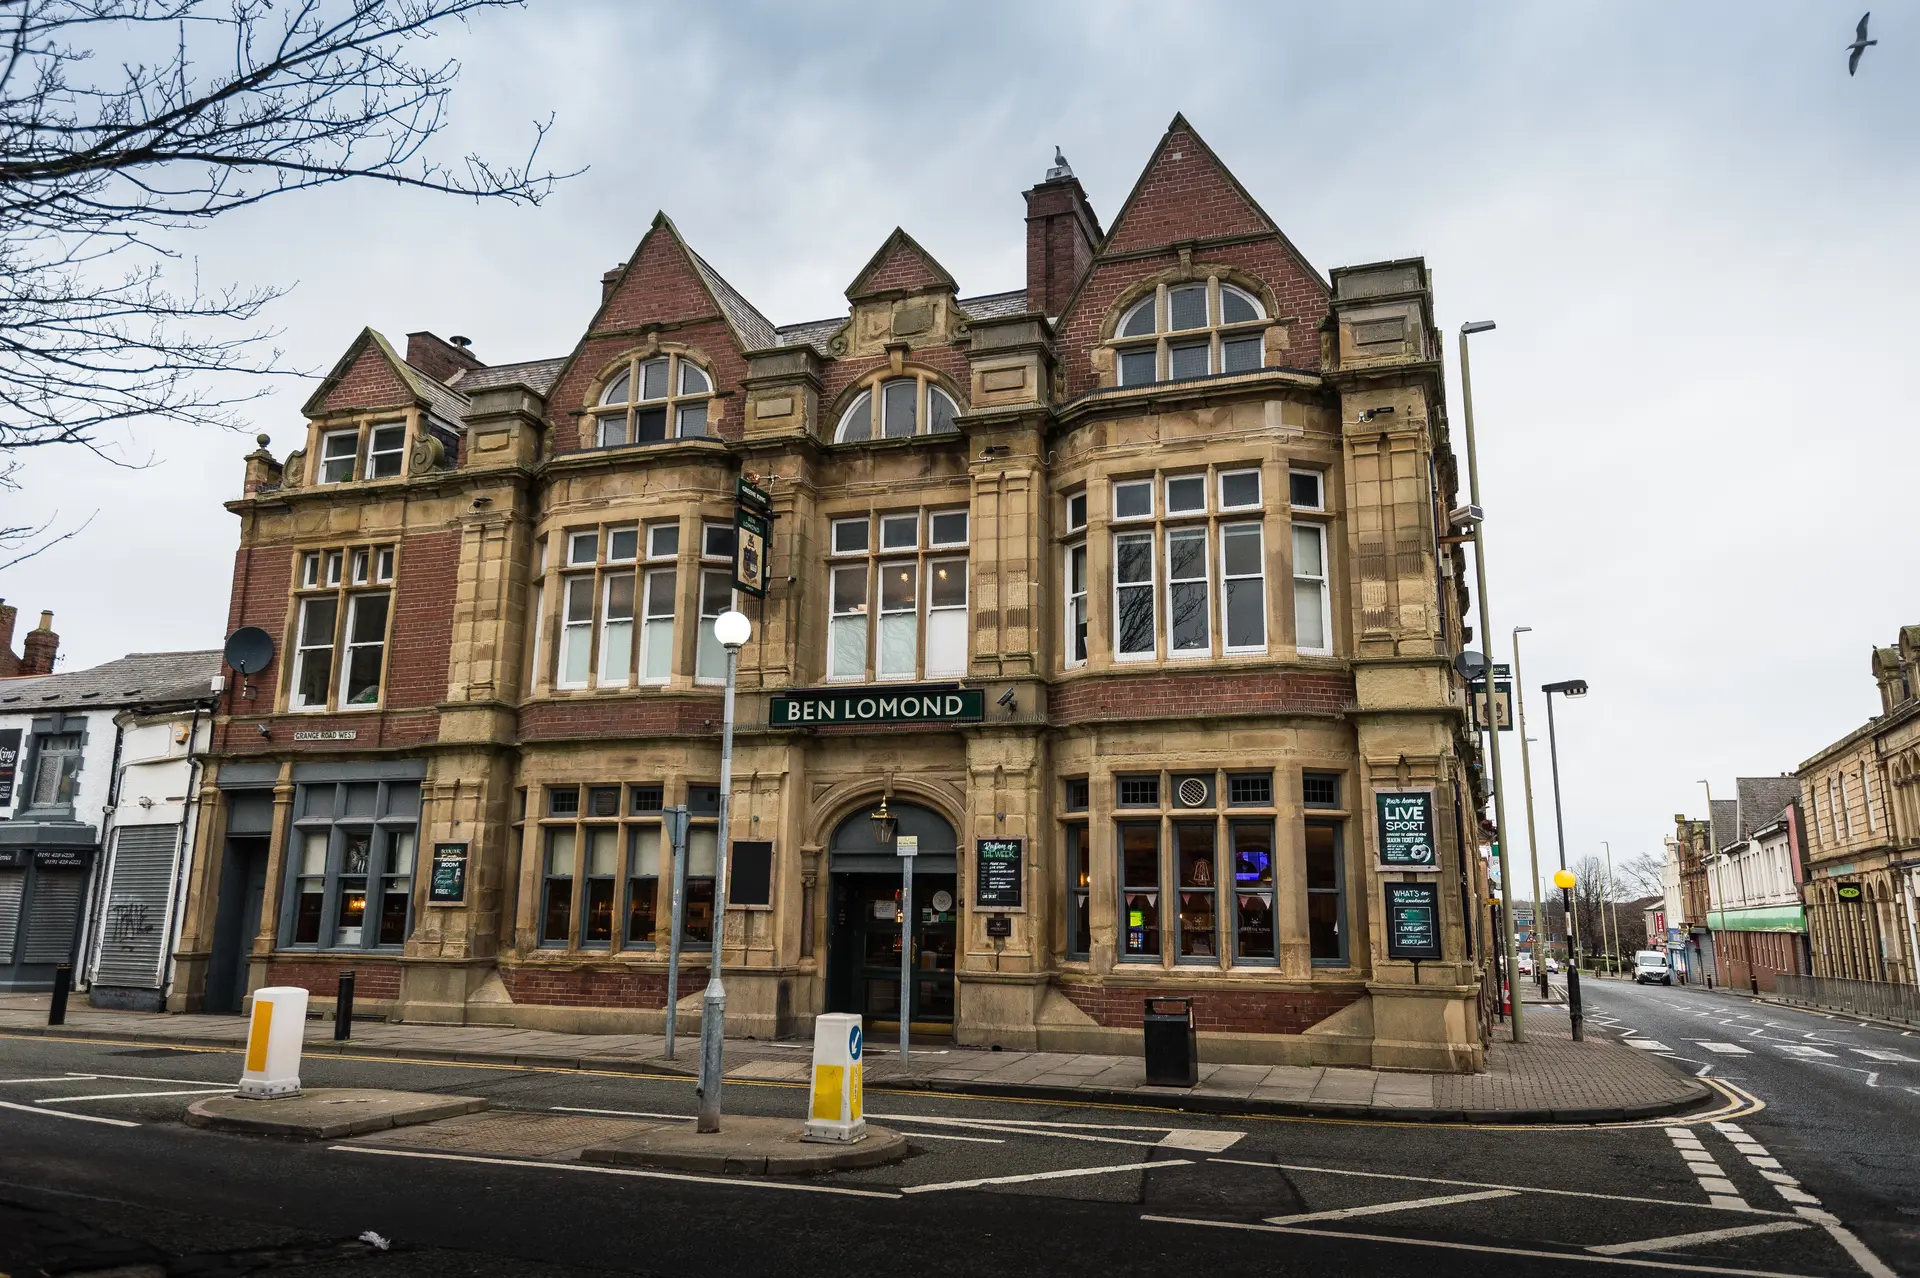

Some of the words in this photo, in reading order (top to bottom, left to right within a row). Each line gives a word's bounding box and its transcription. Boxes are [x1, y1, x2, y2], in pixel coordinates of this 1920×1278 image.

[756, 493, 767, 503] KING
[747, 516, 756, 525] BEN
[742, 521, 760, 534] LOMOND
[788, 700, 835, 721] BEN
[845, 695, 963, 719] LOMOND
[1416, 797, 1424, 805] of
[1384, 806, 1424, 820] LIVE
[1385, 821, 1425, 831] SPORT
[982, 850, 993, 858] THE
